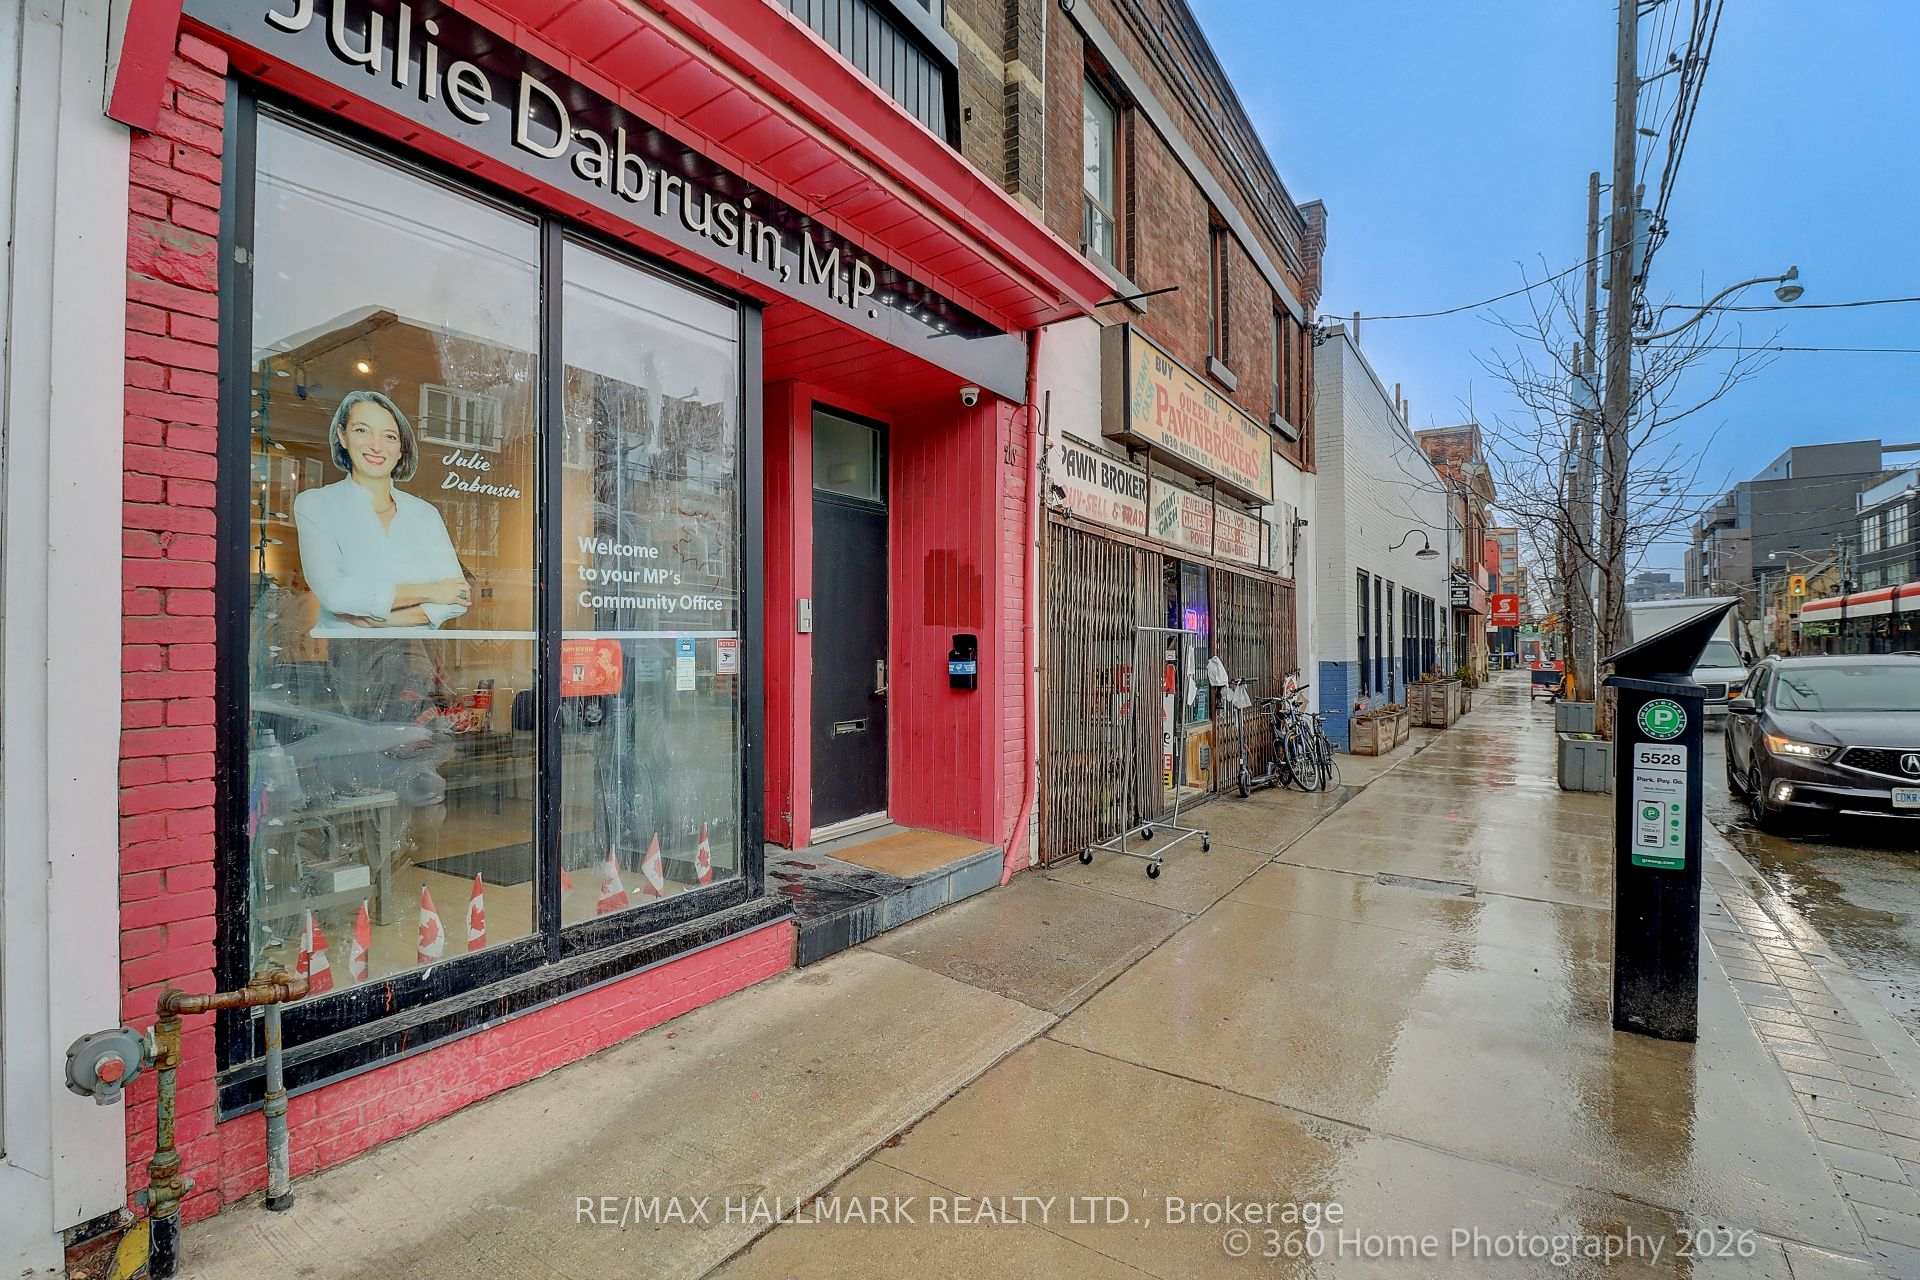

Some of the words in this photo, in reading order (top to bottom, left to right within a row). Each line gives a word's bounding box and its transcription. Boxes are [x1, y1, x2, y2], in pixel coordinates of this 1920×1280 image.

[516, 71, 792, 282] Dabrusin,
[803, 231, 878, 319] M.P.
[1155, 356, 1174, 381] BUY
[1155, 383, 1260, 481] PAWNBROKERS
[442, 449, 490, 471] Julie
[441, 471, 520, 498] Dabrusin
[1101, 462, 1146, 504] BROKER
[1122, 504, 1146, 528] TRAD
[1159, 507, 1178, 535] CASH
[577, 536, 659, 559] Welcome
[578, 567, 597, 581] to
[601, 569, 640, 586] your
[643, 570, 681, 585] MP's
[579, 591, 676, 613] Community
[679, 594, 723, 611] Office
[1654, 709, 1673, 726] P
[1639, 752, 1681, 766] 5528
